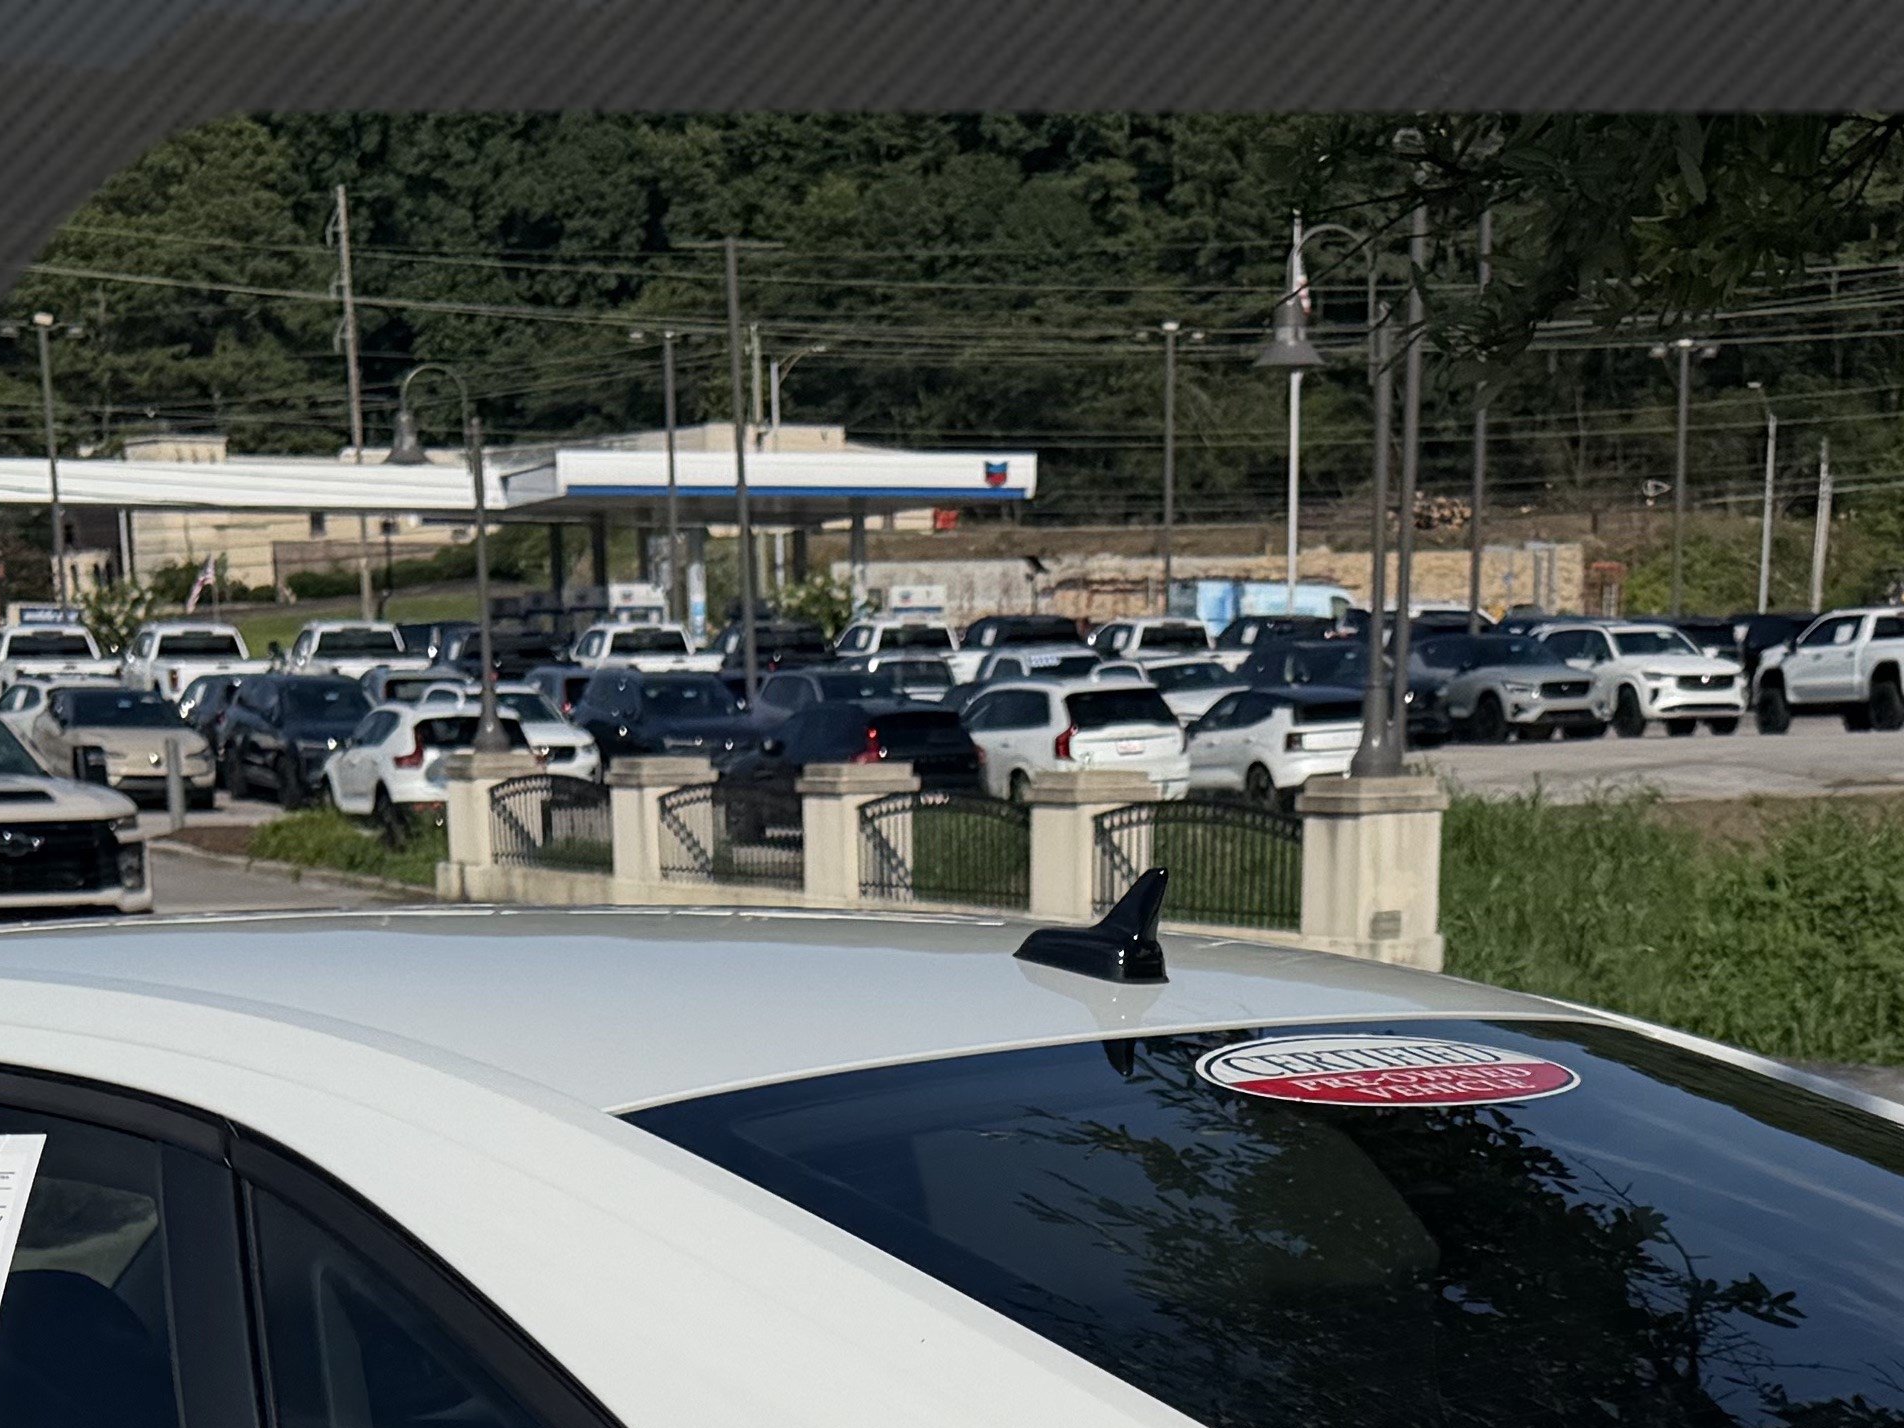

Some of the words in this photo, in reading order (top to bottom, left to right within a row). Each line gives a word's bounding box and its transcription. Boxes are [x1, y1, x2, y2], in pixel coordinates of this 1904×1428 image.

[1223, 1042, 1504, 1078] CERTIFIED
[1289, 1065, 1533, 1093] PRE-OWNED
[1355, 1077, 1537, 1100] VEHICLE
